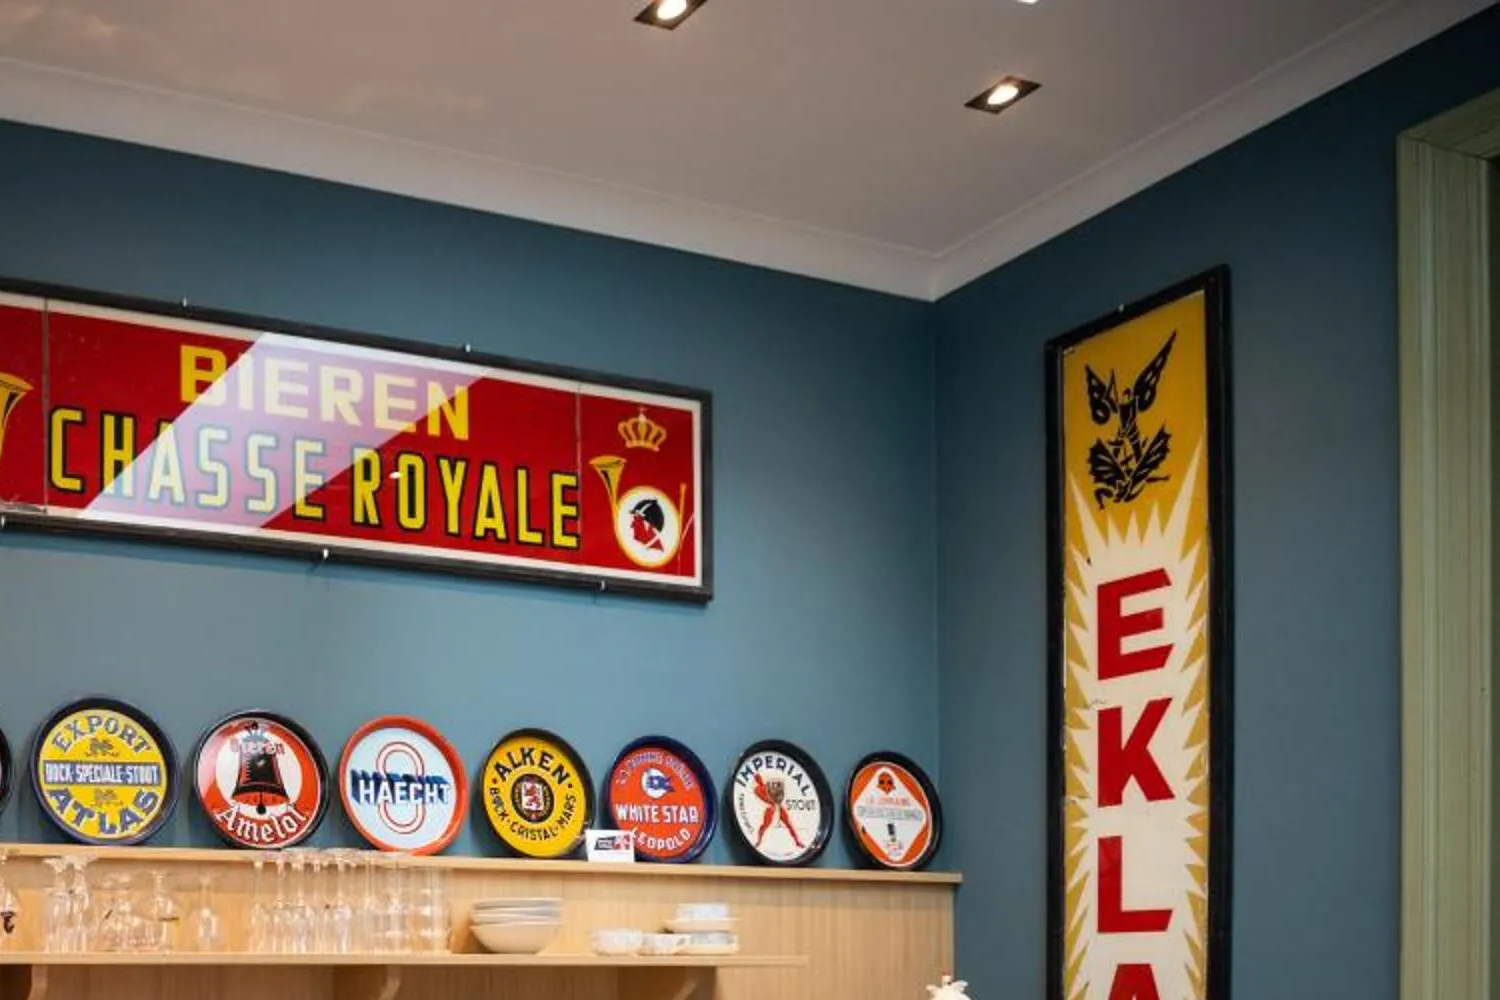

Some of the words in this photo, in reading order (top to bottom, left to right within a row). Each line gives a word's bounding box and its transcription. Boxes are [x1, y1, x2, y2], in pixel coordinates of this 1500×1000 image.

[180, 345, 469, 440] BIEREN
[47, 407, 327, 521] CHASSE
[351, 446, 581, 549] ROYALE
[51, 715, 152, 753] EXPORT
[494, 746, 571, 785] ALKEN
[736, 755, 811, 797] IMPERIAL
[353, 773, 451, 805] HAECHT
[48, 788, 159, 835] ATLAS
[510, 821, 560, 841] CRISTAL
[558, 793, 577, 828] MARS
[615, 803, 660, 823] WHITE
[662, 805, 699, 823] STAR
